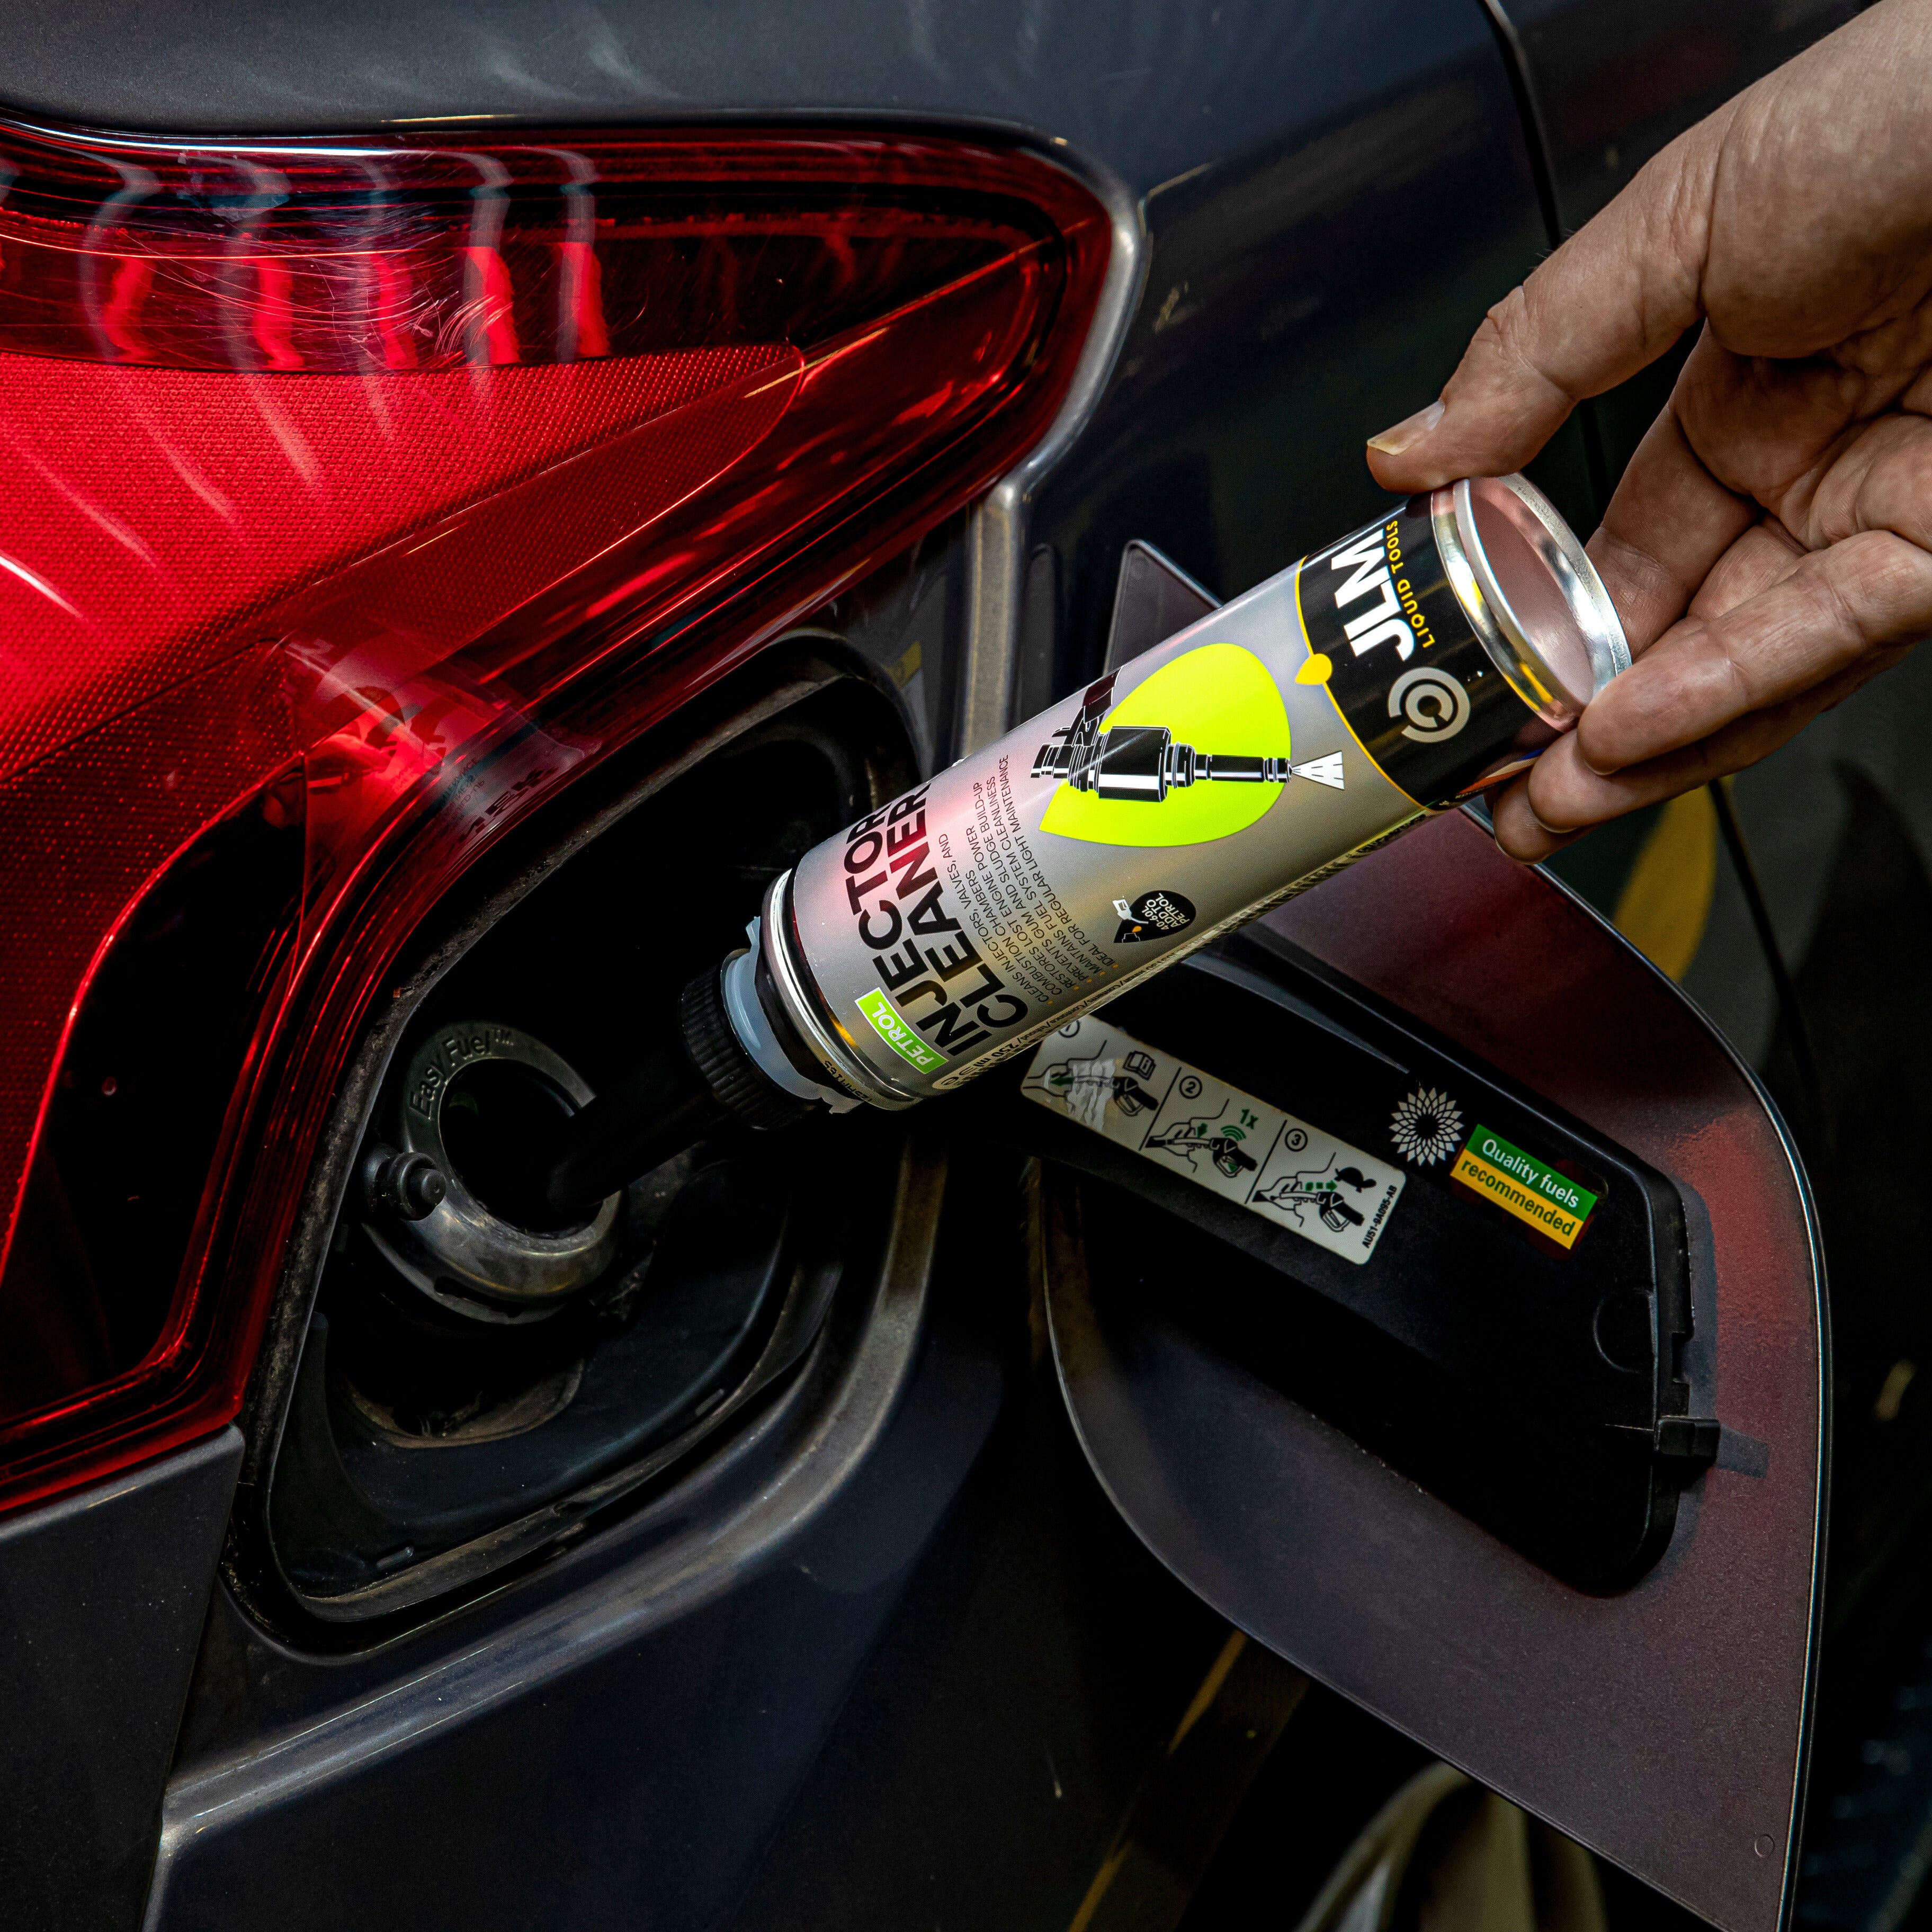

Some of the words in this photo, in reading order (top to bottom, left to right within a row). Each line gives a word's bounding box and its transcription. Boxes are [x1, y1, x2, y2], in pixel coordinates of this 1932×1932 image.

[1386, 520, 1403, 574] TOOLS
[1331, 528, 1416, 661] JLM
[1397, 579, 1435, 648] LIQUID
[973, 782, 990, 833] BUILD-UP
[986, 776, 1012, 851] CLEANLINESS
[999, 754, 1022, 833] MAINTENANCE
[938, 834, 953, 858] AND
[966, 825, 988, 871] POWER
[983, 833, 1009, 883] SLUDGE
[1014, 835, 1038, 871] LIGHT
[947, 860, 971, 909] VALVES,
[981, 871, 1013, 918] ENGINE
[1005, 884, 1027, 909] AND
[1006, 852, 1036, 900] SYSTEM
[1032, 870, 1072, 925] REGULAR
[887, 783, 1028, 1028] CLEANER
[965, 870, 1006, 936] CHAMBERS
[1021, 911, 1045, 939] GUM
[1034, 900, 1058, 931] FUEL
[1141, 906, 1169, 930] 40-60L
[1147, 899, 1162, 914] TO
[1156, 892, 1190, 924] PETROL
[1158, 911, 1182, 927] ADD
[844, 803, 992, 1057] INJECTOR
[969, 909, 1016, 972] INJECTORS,
[1007, 919, 1033, 947] LOST
[1053, 929, 1103, 974] MAINTAINS
[1068, 923, 1090, 945] FOR
[1002, 936, 1062, 996] COMBUSTION
[1028, 946, 1078, 989] RESTORES
[1041, 938, 1089, 982] PREVENTS
[1088, 943, 1114, 967] IDEAL
[1013, 972, 1049, 1003] CLEANS
[872, 1001, 934, 1066] PETROL
[991, 1043, 1019, 1057] 250
[1185, 1081, 1196, 1093] 2
[1240, 1108, 1259, 1130] 1x
[1291, 1134, 1301, 1146] 3
[1482, 1139, 1539, 1185] Quality
[1540, 1174, 1579, 1208] fuels
[1361, 1185, 1398, 1249] AU51-9A095-AB
[1461, 1159, 1576, 1237] recommended
